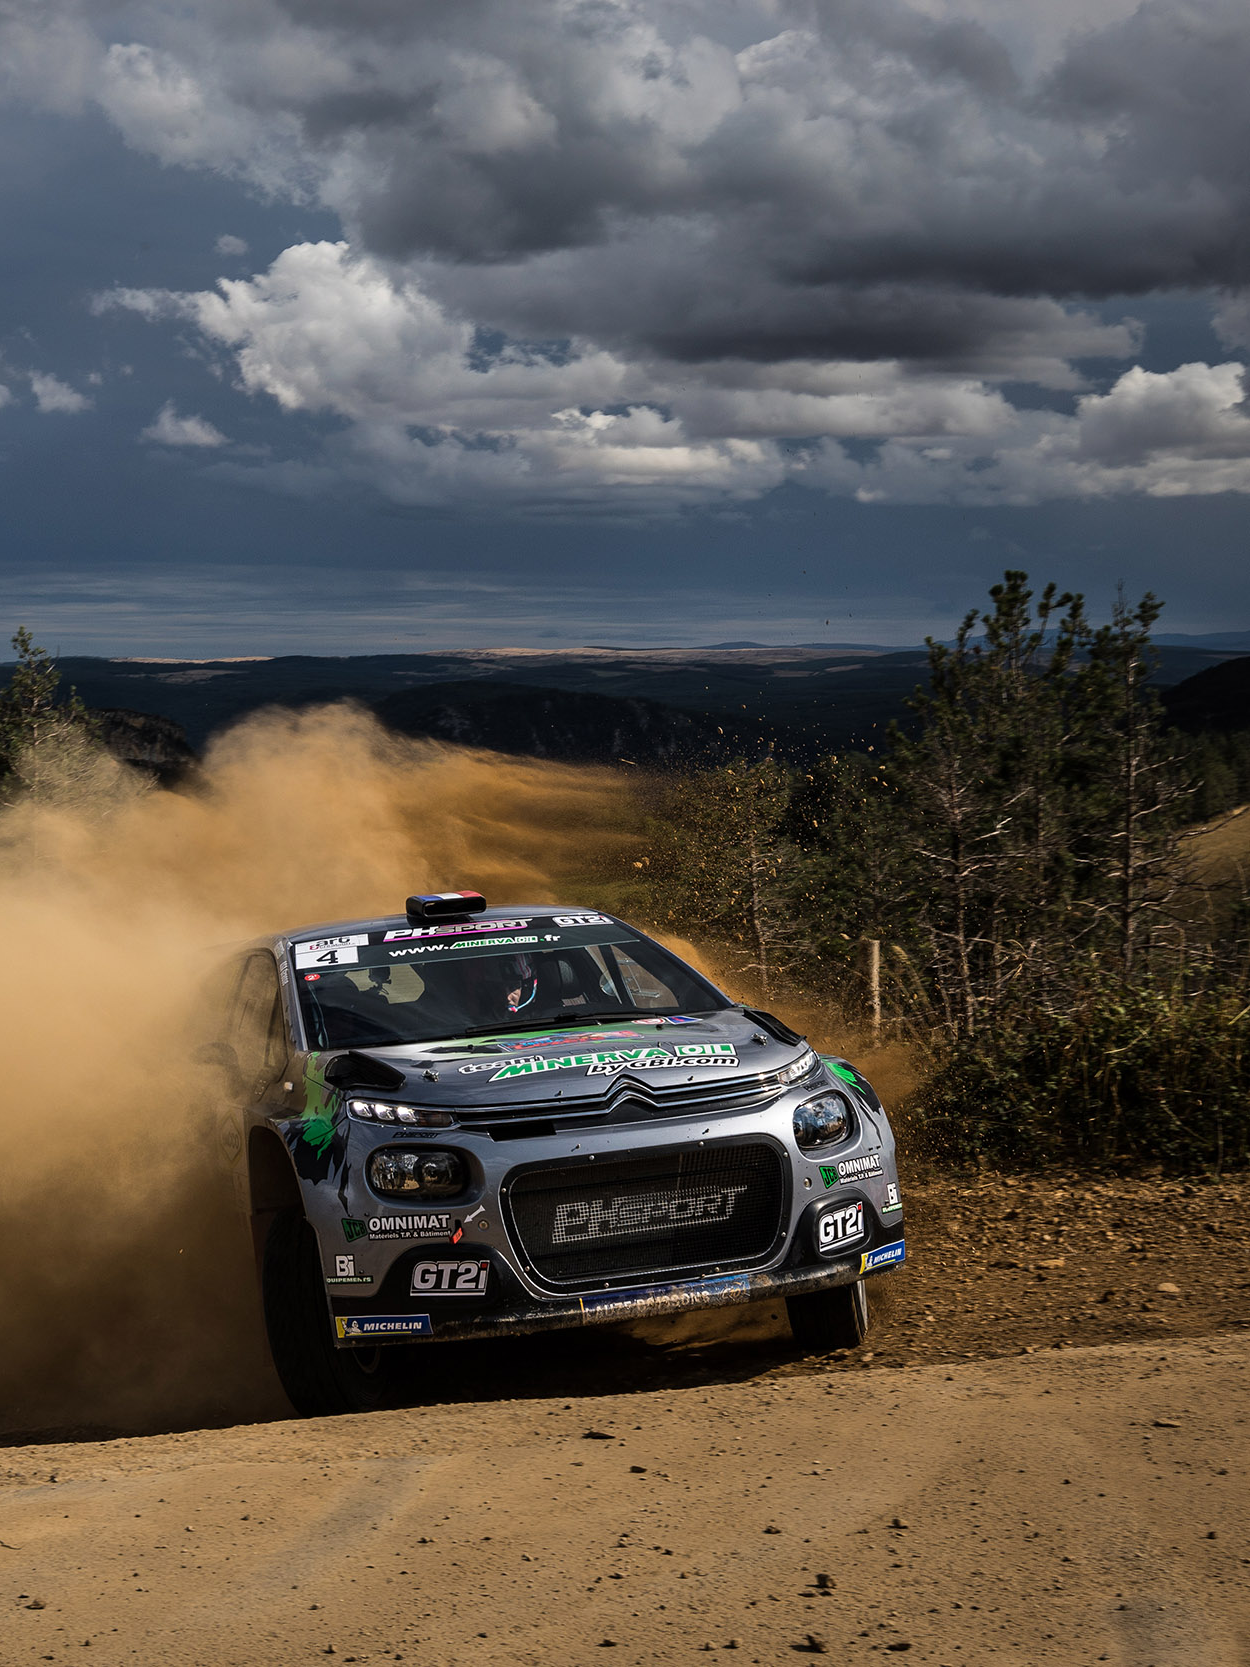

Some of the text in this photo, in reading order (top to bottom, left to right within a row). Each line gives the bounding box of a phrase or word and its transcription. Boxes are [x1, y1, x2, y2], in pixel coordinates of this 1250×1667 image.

[384, 919, 532, 940] PHSPORT
[554, 915, 612, 926] GT2i
[316, 950, 338, 964] 4
[459, 1045, 733, 1080] team MINERVA OIL
[589, 1056, 737, 1075] by GBI.com
[839, 1155, 880, 1175] OMNIMAT
[369, 1215, 449, 1230] OMNIMAT
[552, 1185, 747, 1243] PHSPORT
[820, 1204, 863, 1243] GT2i
[346, 1220, 366, 1237] JCB
[336, 1255, 354, 1276] Bi
[873, 1248, 902, 1264] MICHELIN
[414, 1262, 488, 1289] GT2i
[363, 1322, 422, 1331] MICHELIN
